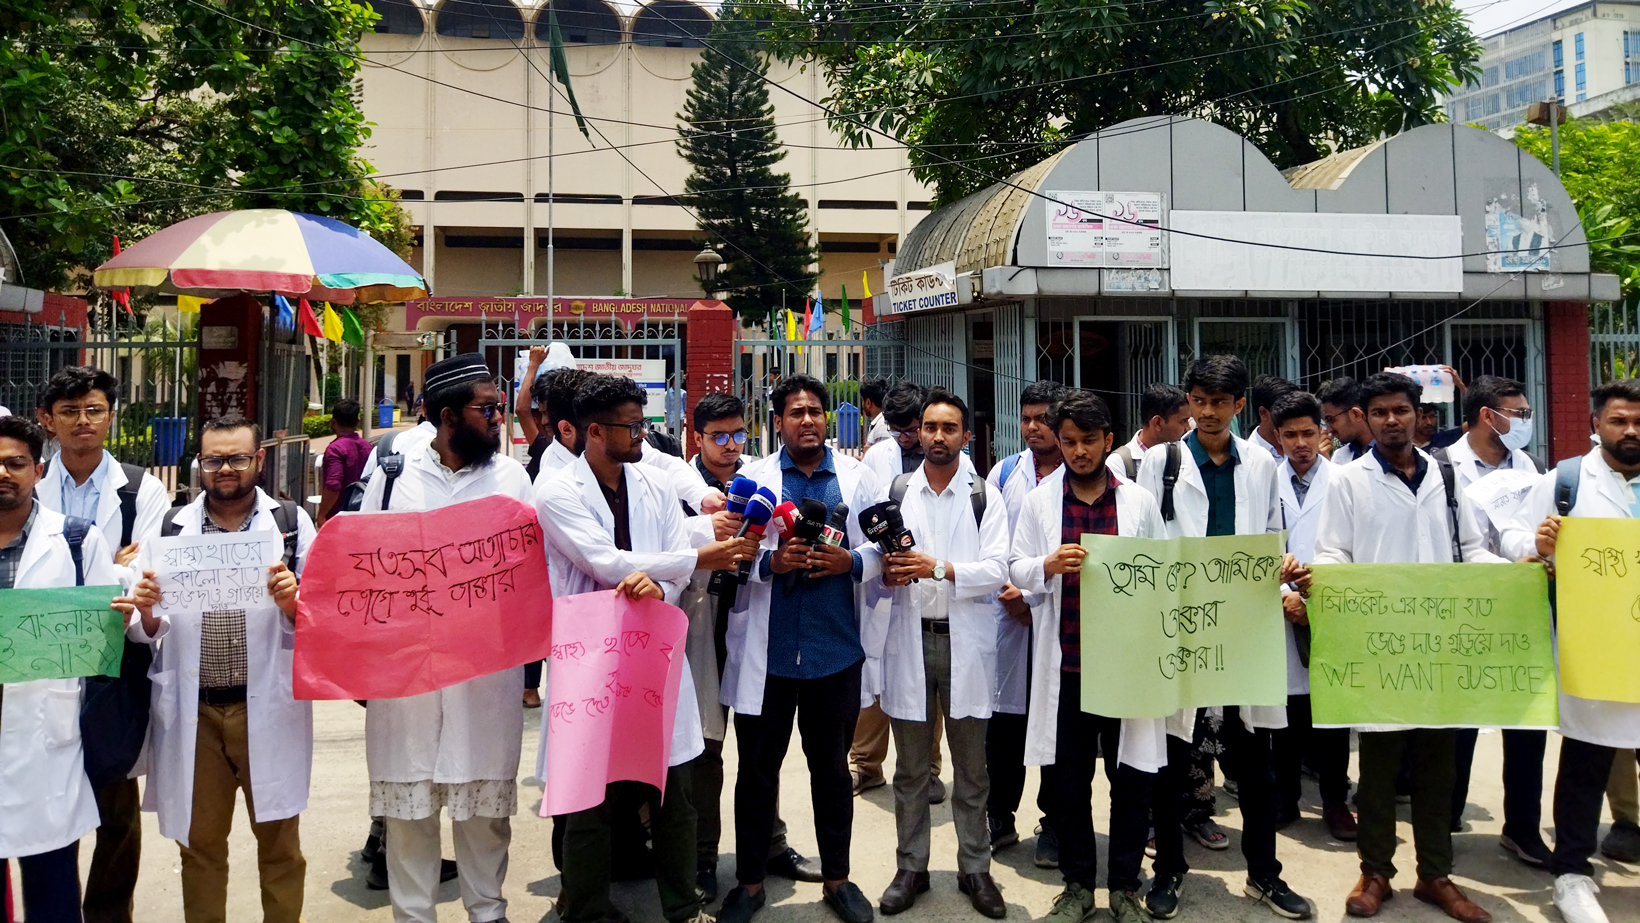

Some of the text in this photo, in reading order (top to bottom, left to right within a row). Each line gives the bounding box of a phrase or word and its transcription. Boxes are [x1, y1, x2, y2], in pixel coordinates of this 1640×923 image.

[888, 277, 913, 298] টিকিট
[416, 301, 473, 312] বাংলাদেশ
[478, 299, 515, 312] জাতীয়
[592, 303, 647, 313] BANGLADESH
[893, 292, 957, 312] TICKET COUNTER
[595, 362, 617, 370] জাতীয়
[618, 364, 642, 372] জাদুঘর
[206, 541, 270, 566] খাতের
[458, 521, 539, 568] অত্যাচার
[169, 566, 270, 587] কালো হাত
[1102, 554, 1164, 596] তুমি
[1166, 561, 1197, 592] কে?
[1200, 551, 1254, 584] আমি
[1463, 597, 1498, 617] হাত
[17, 610, 110, 640] বাংলায়
[1160, 600, 1226, 638] ডাক্তার
[1410, 632, 1442, 655] দাও
[1499, 632, 1531, 655] দাও
[1320, 662, 1547, 695] WE WANT JUSTICE
